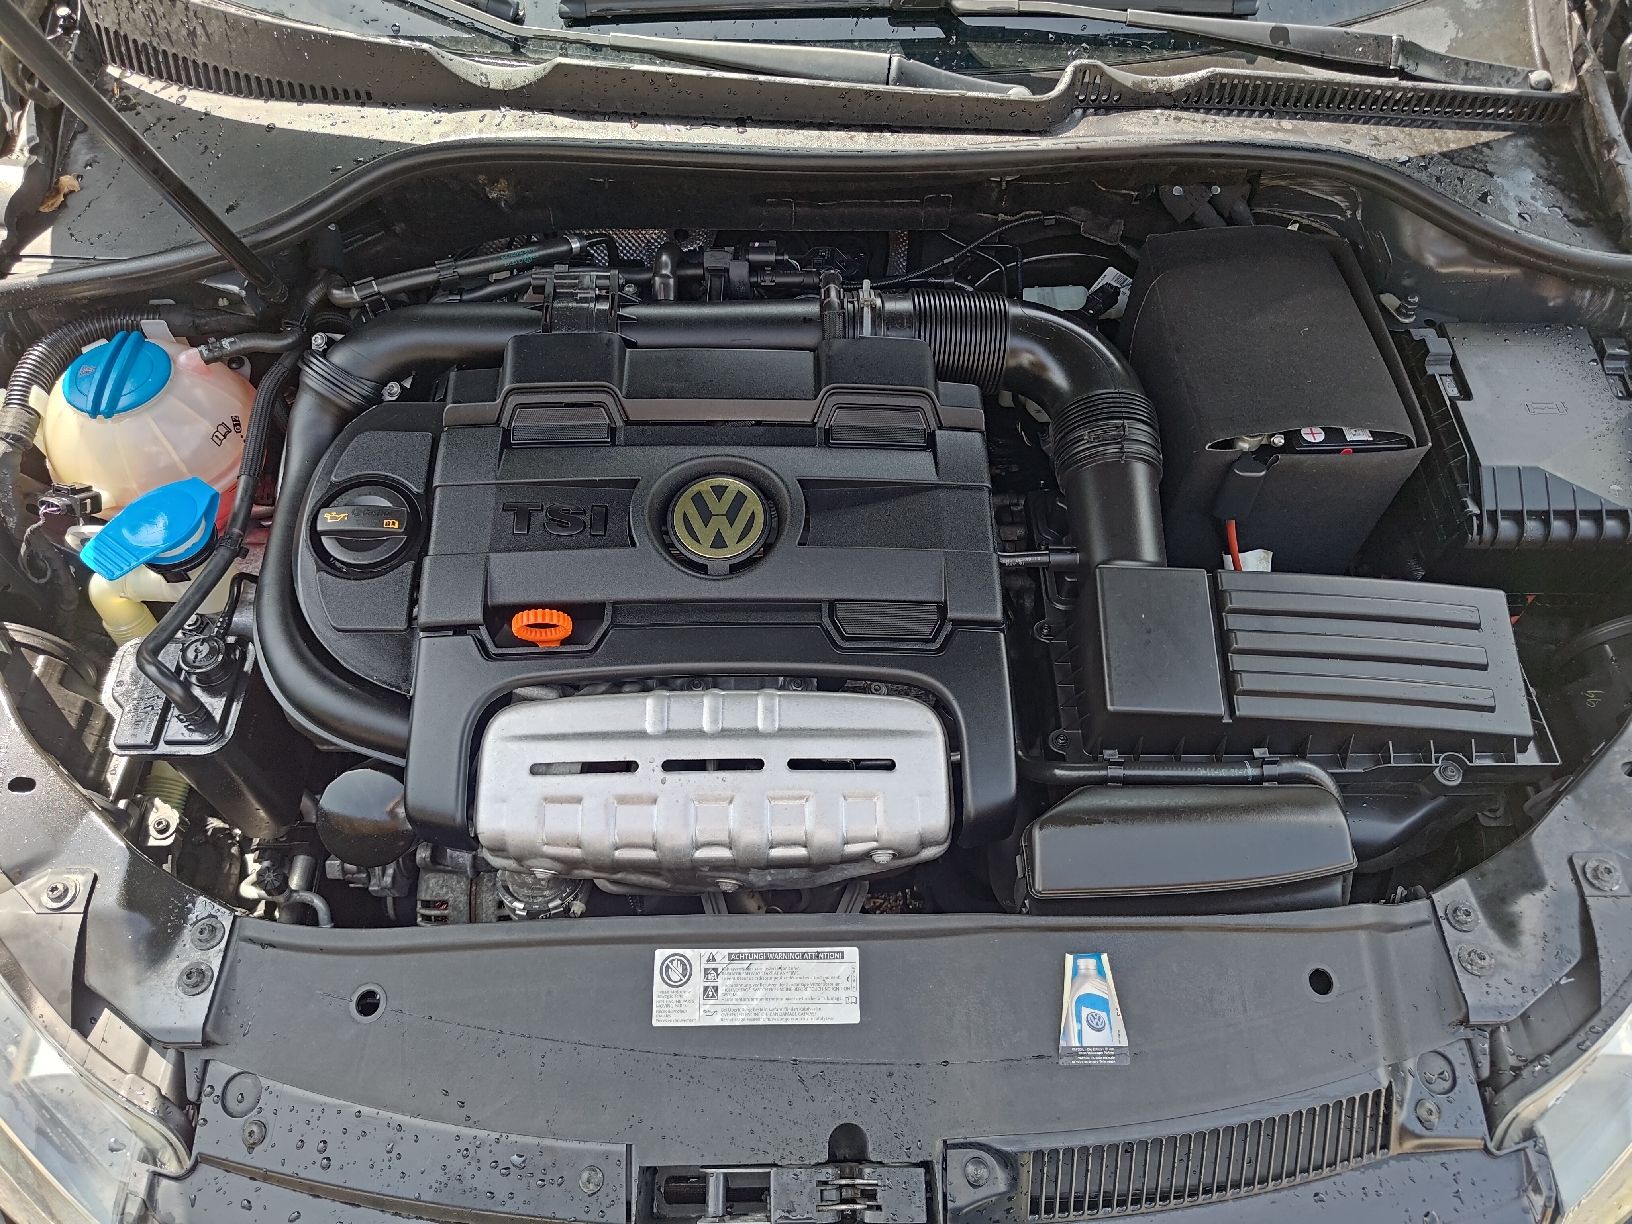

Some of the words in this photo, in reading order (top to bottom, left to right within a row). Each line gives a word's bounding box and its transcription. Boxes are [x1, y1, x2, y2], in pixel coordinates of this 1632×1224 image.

[502, 501, 609, 536] TSI
[730, 952, 766, 960] ACHTUNG!
[767, 952, 802, 960] WARNING!
